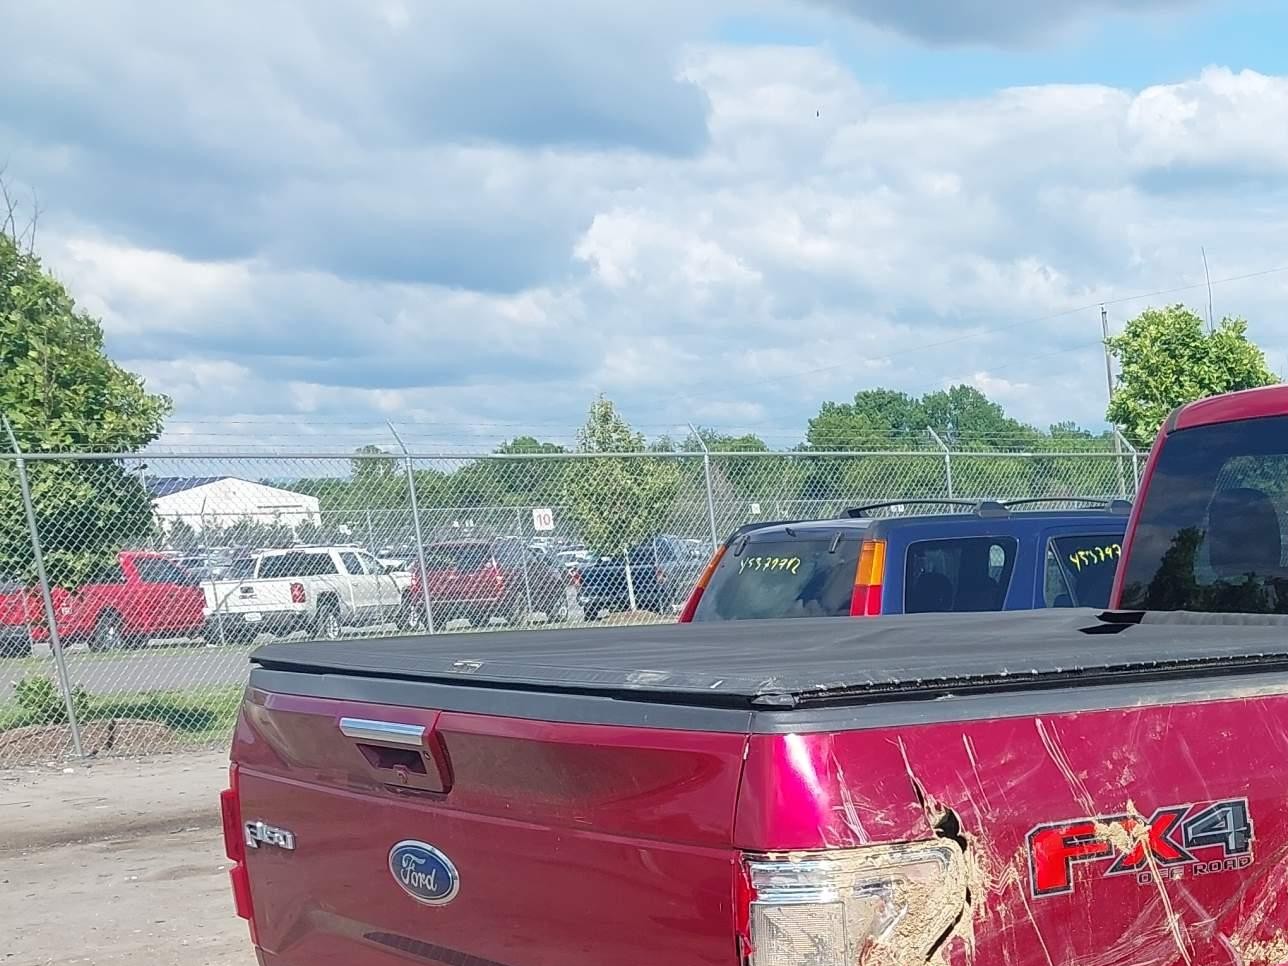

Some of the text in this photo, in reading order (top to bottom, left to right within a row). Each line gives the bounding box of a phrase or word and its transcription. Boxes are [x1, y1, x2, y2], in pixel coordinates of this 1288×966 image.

[537, 514, 551, 526] 10
[1025, 797, 1254, 898] FX4
[400, 854, 437, 891] Ford
[1192, 855, 1253, 876] ROAD
